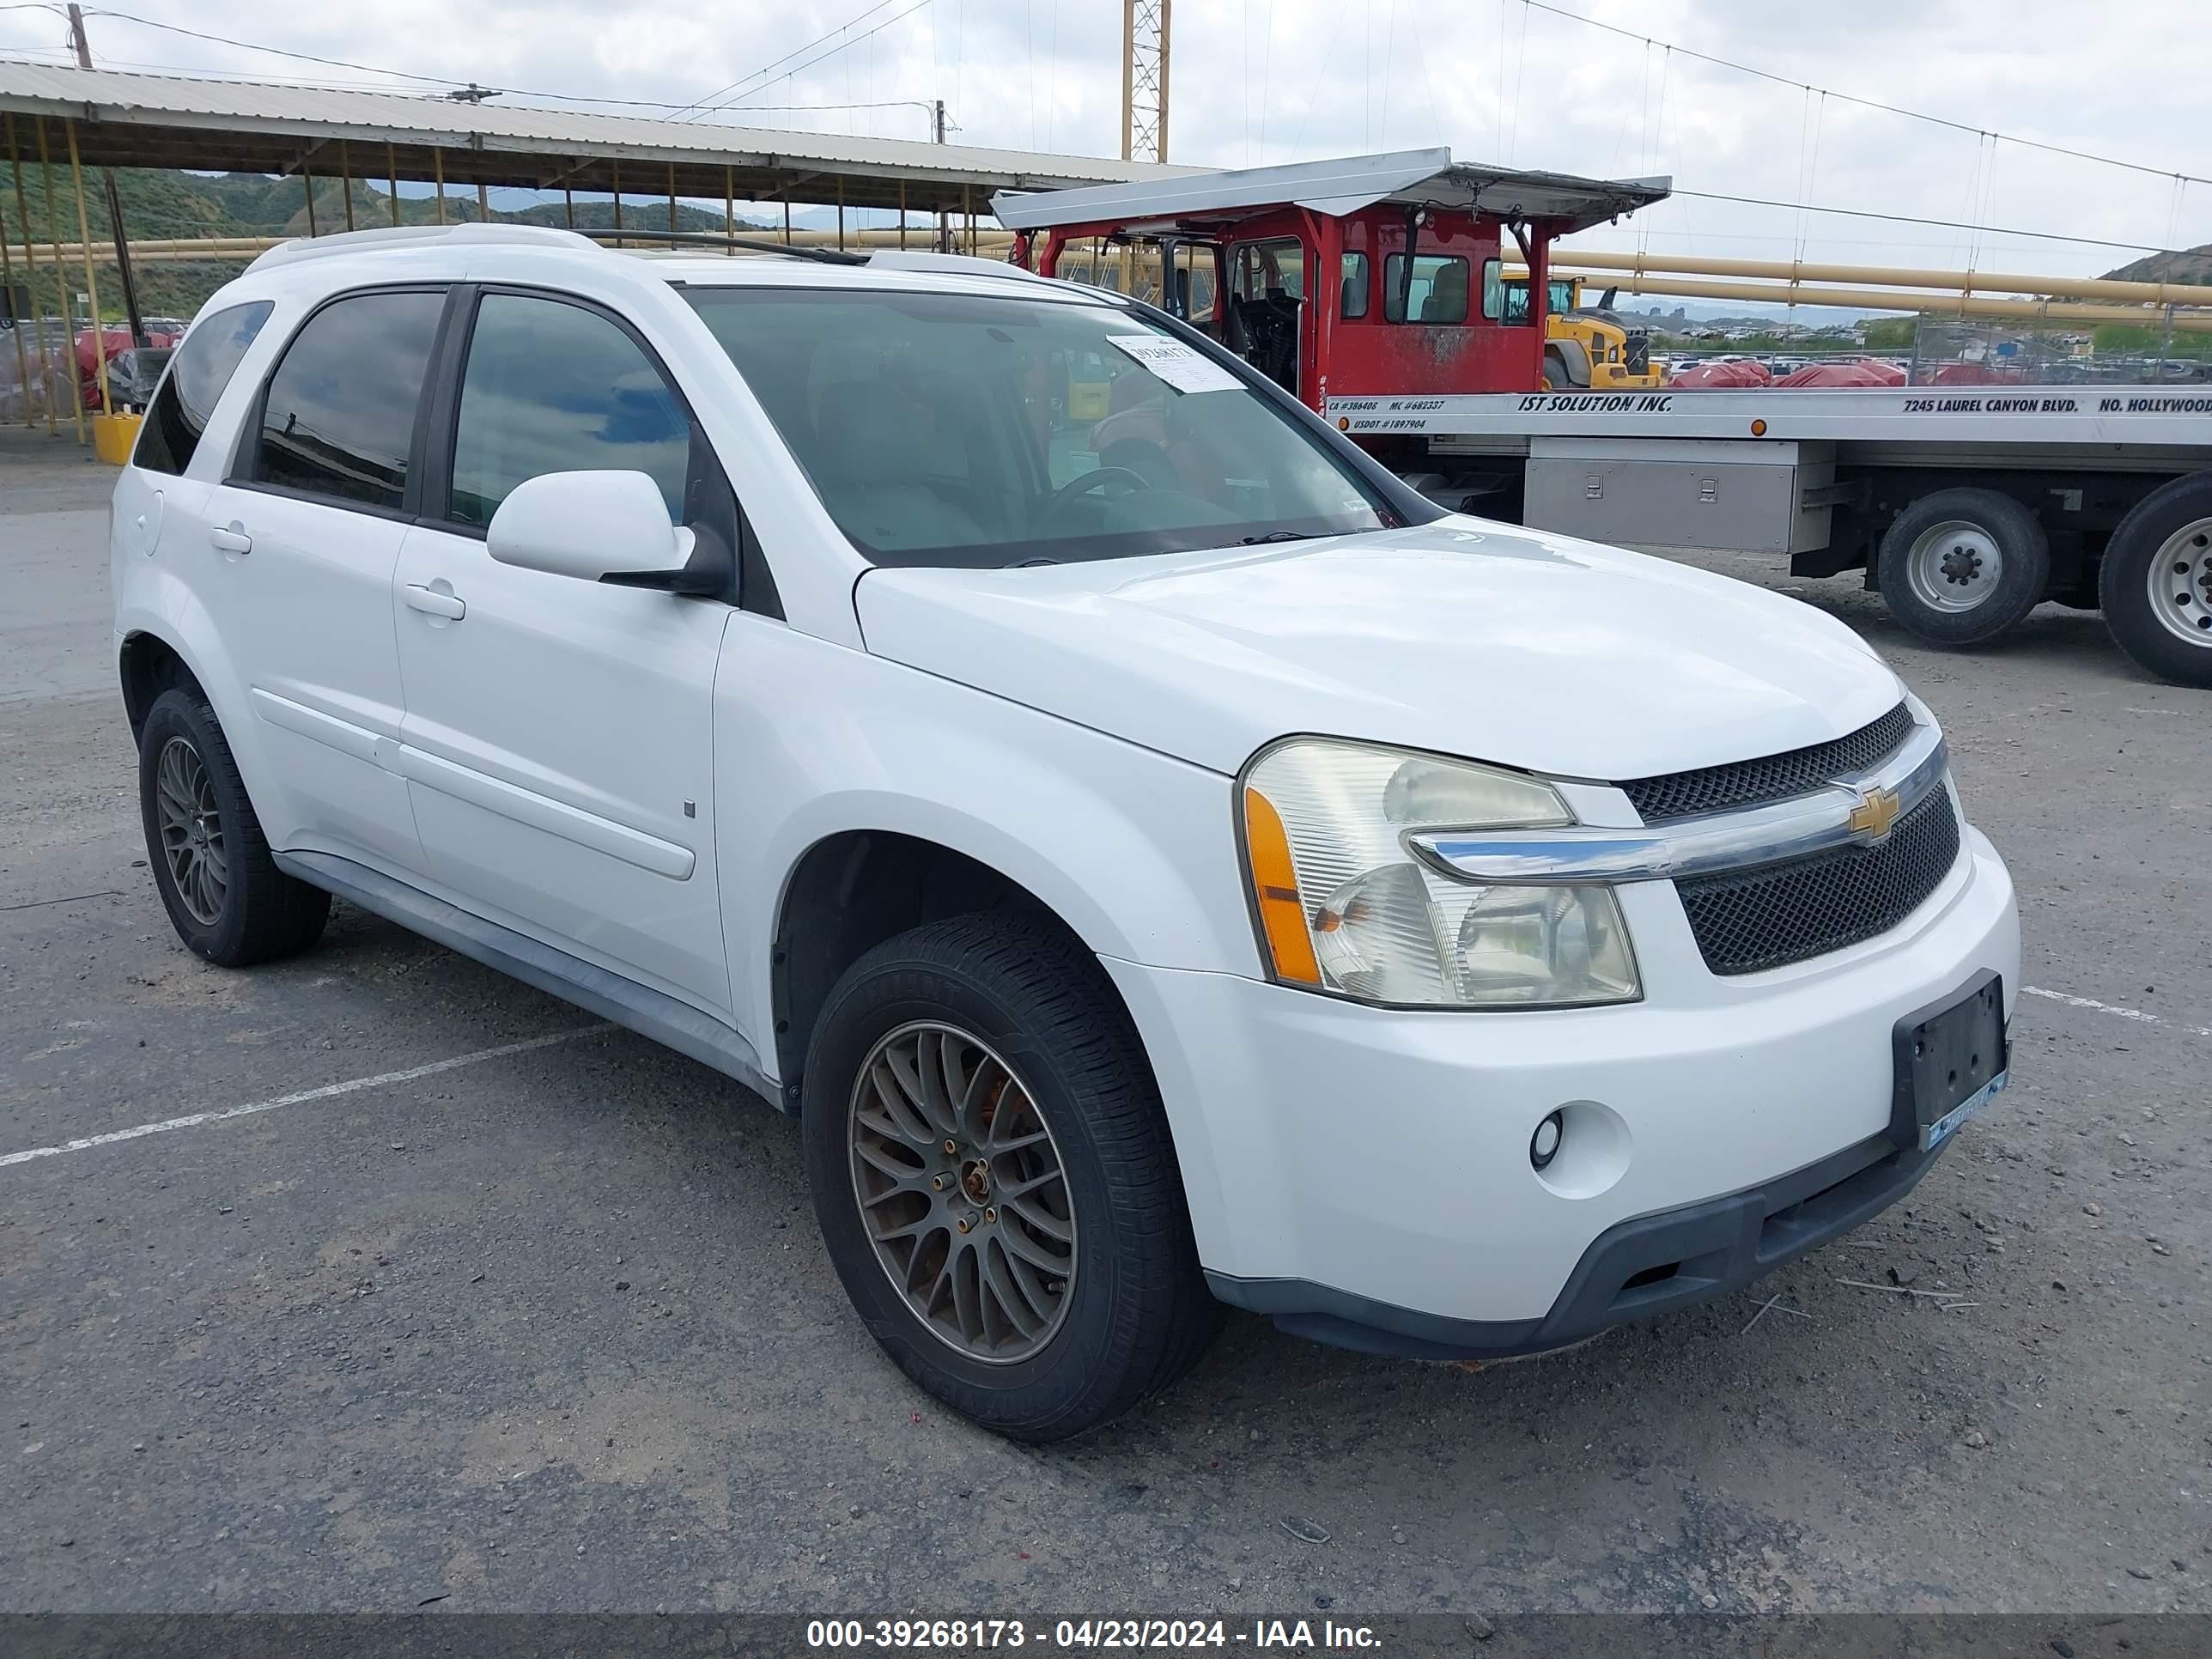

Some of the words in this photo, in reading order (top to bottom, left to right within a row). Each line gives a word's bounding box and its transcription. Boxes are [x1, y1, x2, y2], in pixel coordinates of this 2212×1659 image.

[1130, 347, 1194, 359] 39268173
[1328, 402, 1340, 410] CA
[1389, 401, 1404, 410] MC
[1547, 396, 1635, 411] SOLUTION
[1637, 396, 1672, 412] INC.
[1904, 399, 1934, 412] 7245
[1936, 399, 1981, 412] LAUREL
[1985, 399, 2038, 412] CANYON
[2041, 399, 2078, 412] BLVD.
[2100, 399, 2123, 412] NO.
[2128, 398, 2212, 412] HOLLYWOOD
[1353, 420, 1382, 428] USDOT
[1382, 419, 1426, 429] #1897904
